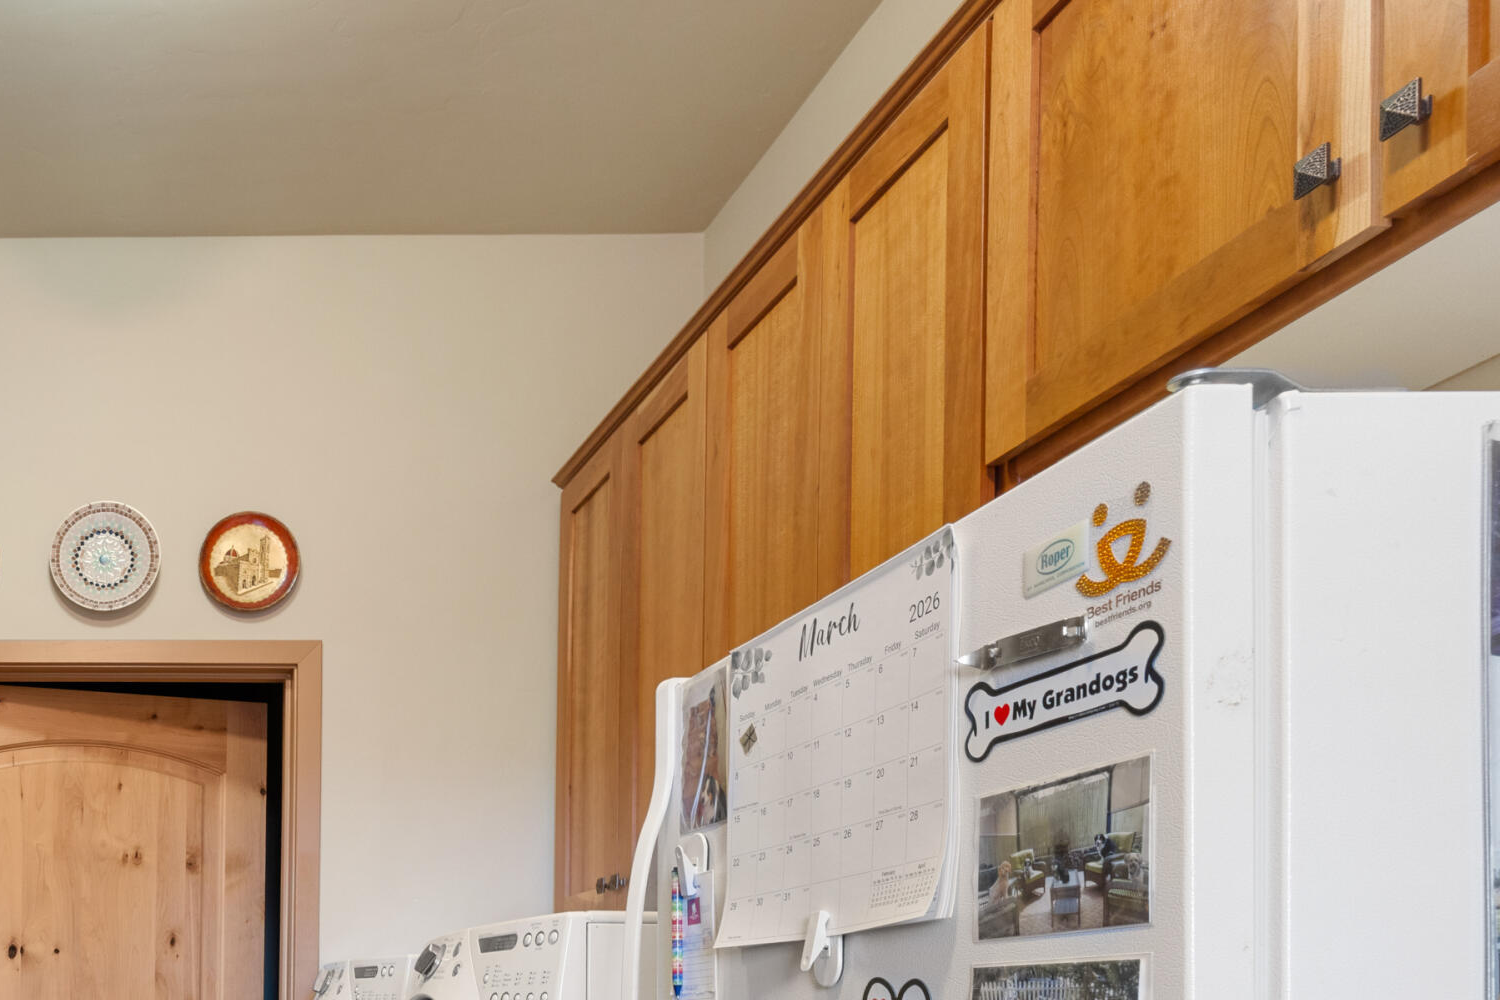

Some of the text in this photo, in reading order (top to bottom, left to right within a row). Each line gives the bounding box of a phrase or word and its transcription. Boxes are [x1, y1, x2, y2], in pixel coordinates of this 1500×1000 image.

[1041, 544, 1071, 570] Roper
[909, 591, 940, 623] 2026
[1086, 580, 1162, 620] Best Friends
[1094, 600, 1152, 628] bestfriends.org
[799, 602, 861, 662] March
[791, 686, 808, 698] Tuesday
[813, 670, 842, 687] Wednesday
[848, 655, 872, 672] Thursday
[884, 640, 902, 655] Friday
[914, 621, 941, 640] Saturday
[985, 665, 1139, 729] I My Grandogs
[844, 728, 852, 738] 12
[877, 715, 885, 726] 13
[911, 701, 919, 712] 14
[844, 779, 852, 789] 19
[876, 768, 885, 779] 20
[910, 756, 918, 768] 21
[813, 838, 820, 847] 25
[843, 828, 852, 839] 26
[875, 820, 884, 831] 27
[910, 810, 919, 821] 28
